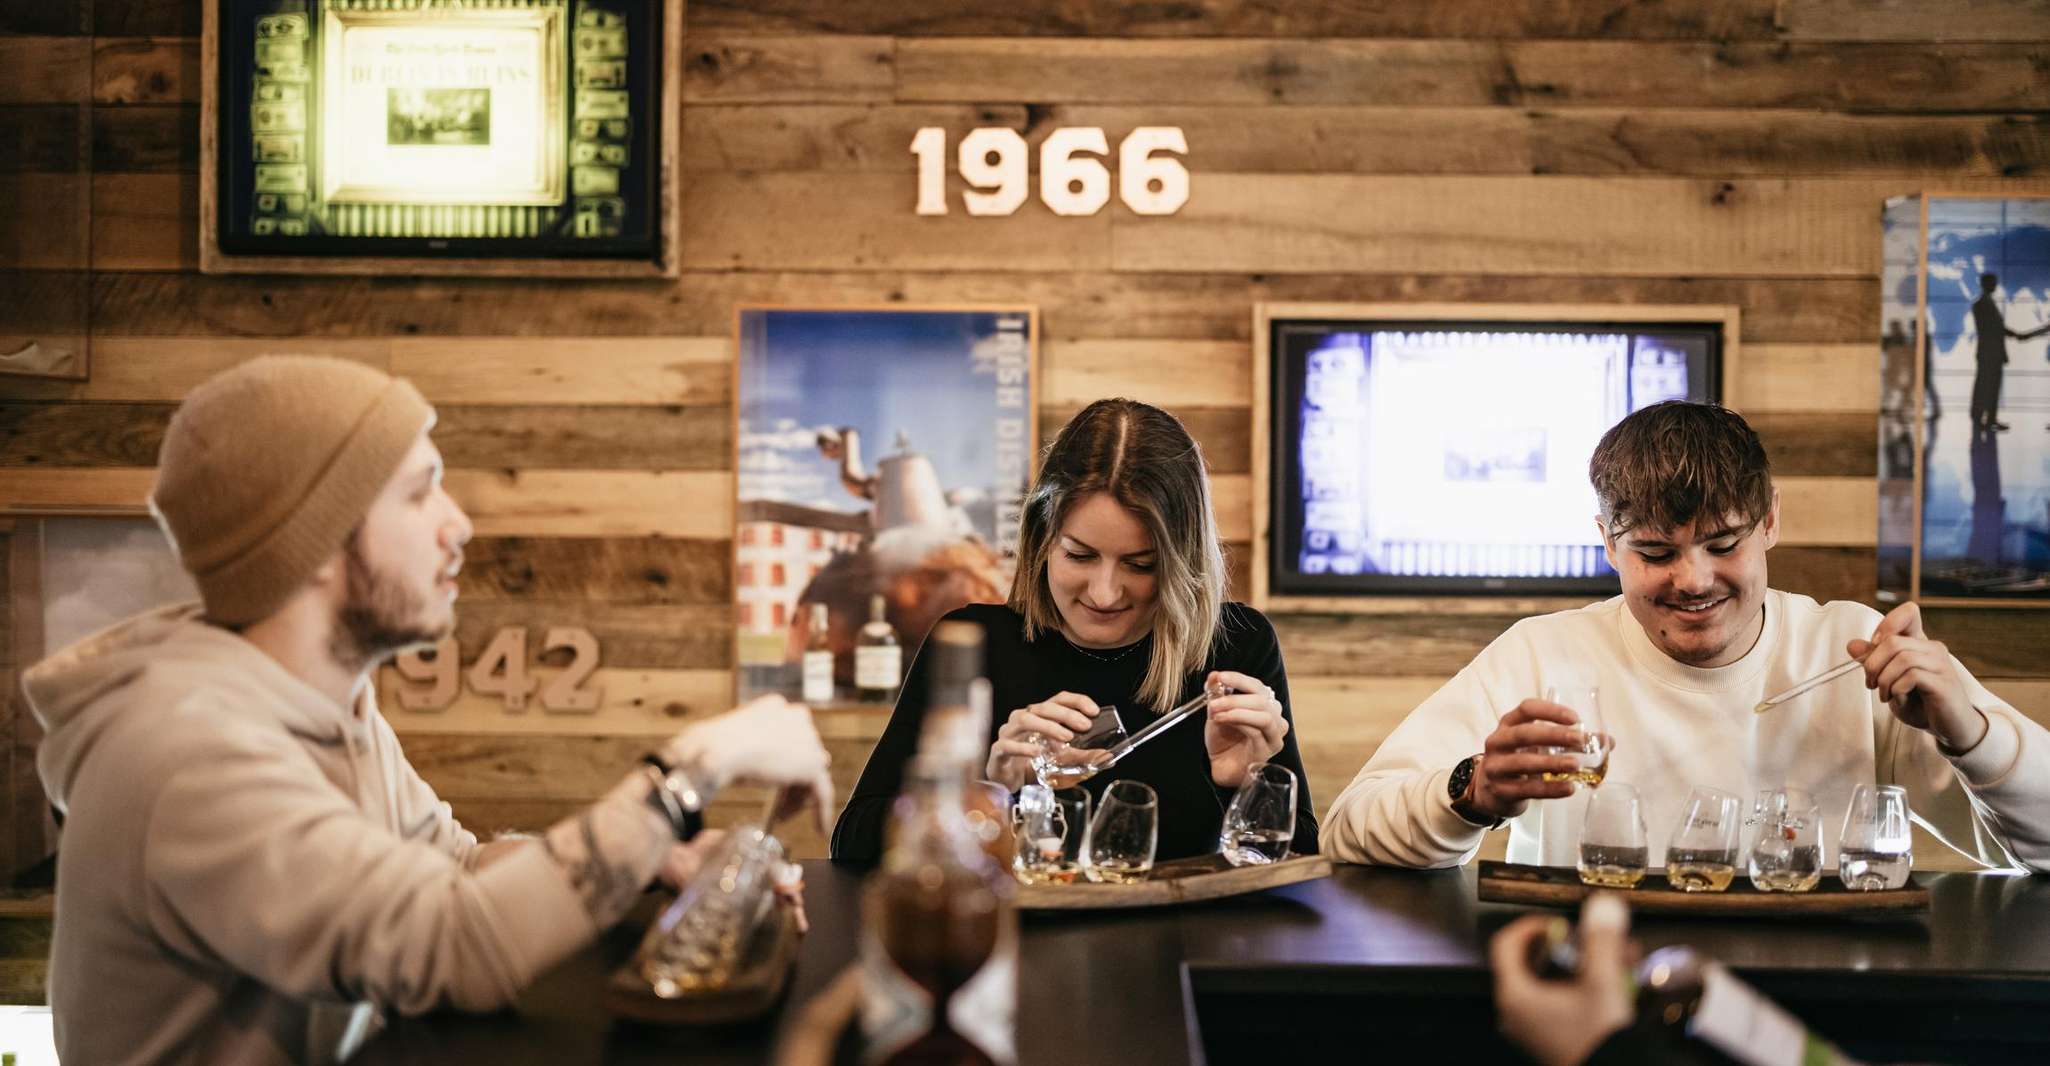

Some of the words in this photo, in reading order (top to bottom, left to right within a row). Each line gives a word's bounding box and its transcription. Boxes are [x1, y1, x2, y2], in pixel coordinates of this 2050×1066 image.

[910, 126, 1190, 216] 1966
[997, 319, 1023, 407] IRISH
[369, 627, 602, 713] 942
